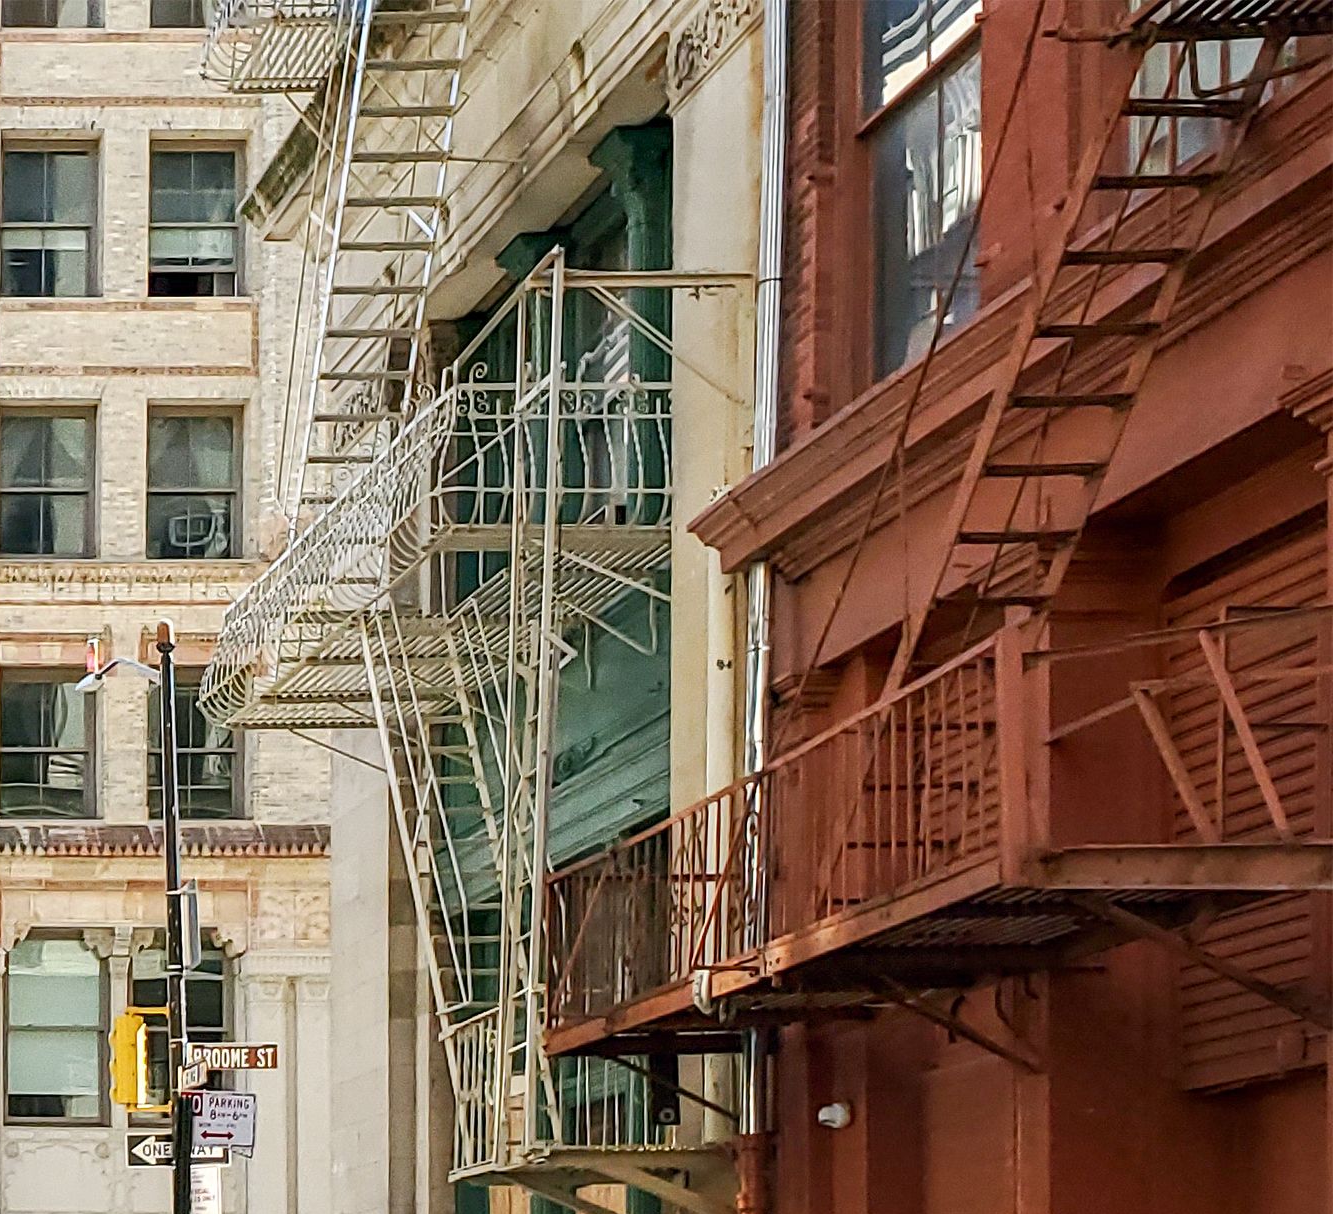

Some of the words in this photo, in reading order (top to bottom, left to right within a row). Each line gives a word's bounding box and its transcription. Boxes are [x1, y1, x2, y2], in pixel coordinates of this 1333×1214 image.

[193, 1048, 249, 1068] BROOME
[256, 1048, 274, 1068] ST
[209, 1097, 250, 1109] PARKING
[142, 1144, 171, 1156] ONE
